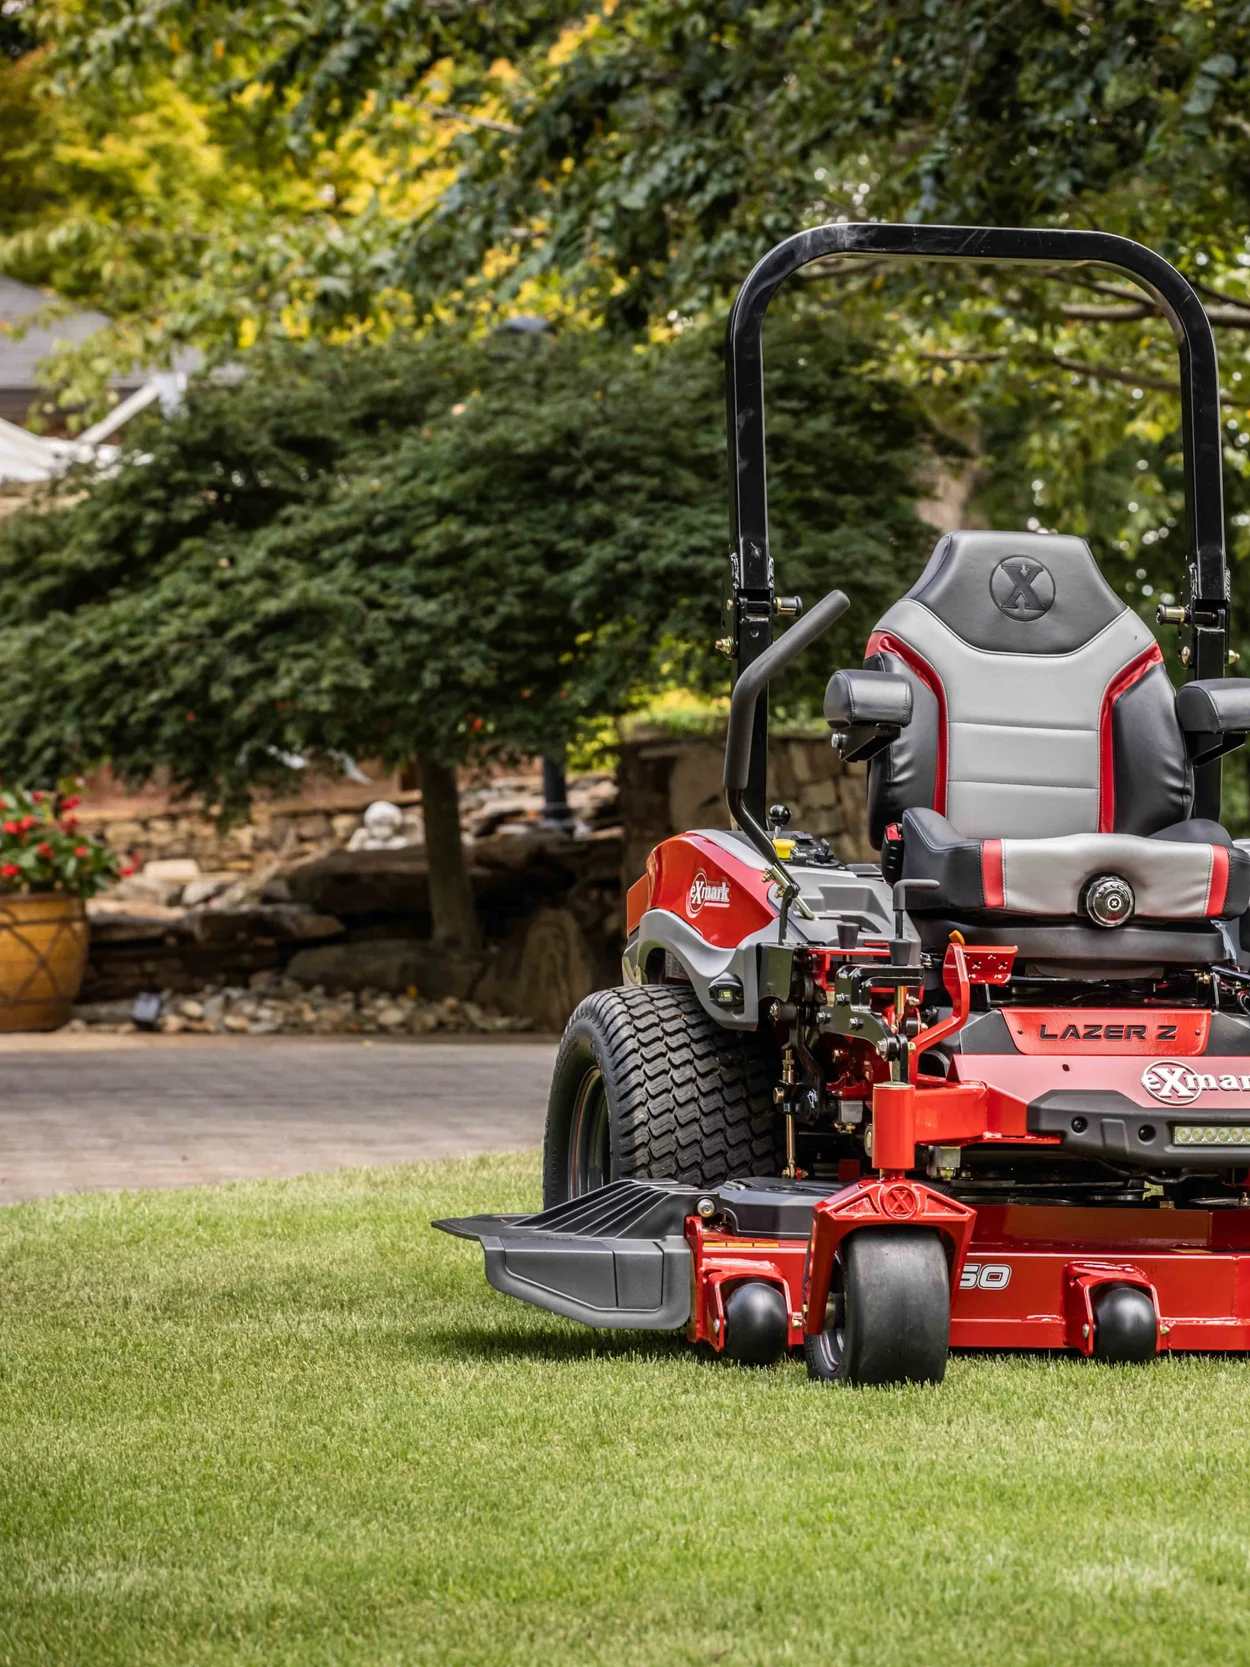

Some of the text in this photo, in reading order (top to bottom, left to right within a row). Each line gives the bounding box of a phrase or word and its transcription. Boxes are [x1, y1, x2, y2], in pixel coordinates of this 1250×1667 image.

[1000, 563, 1047, 612] X
[1039, 1023, 1179, 1042] LAZER Z
